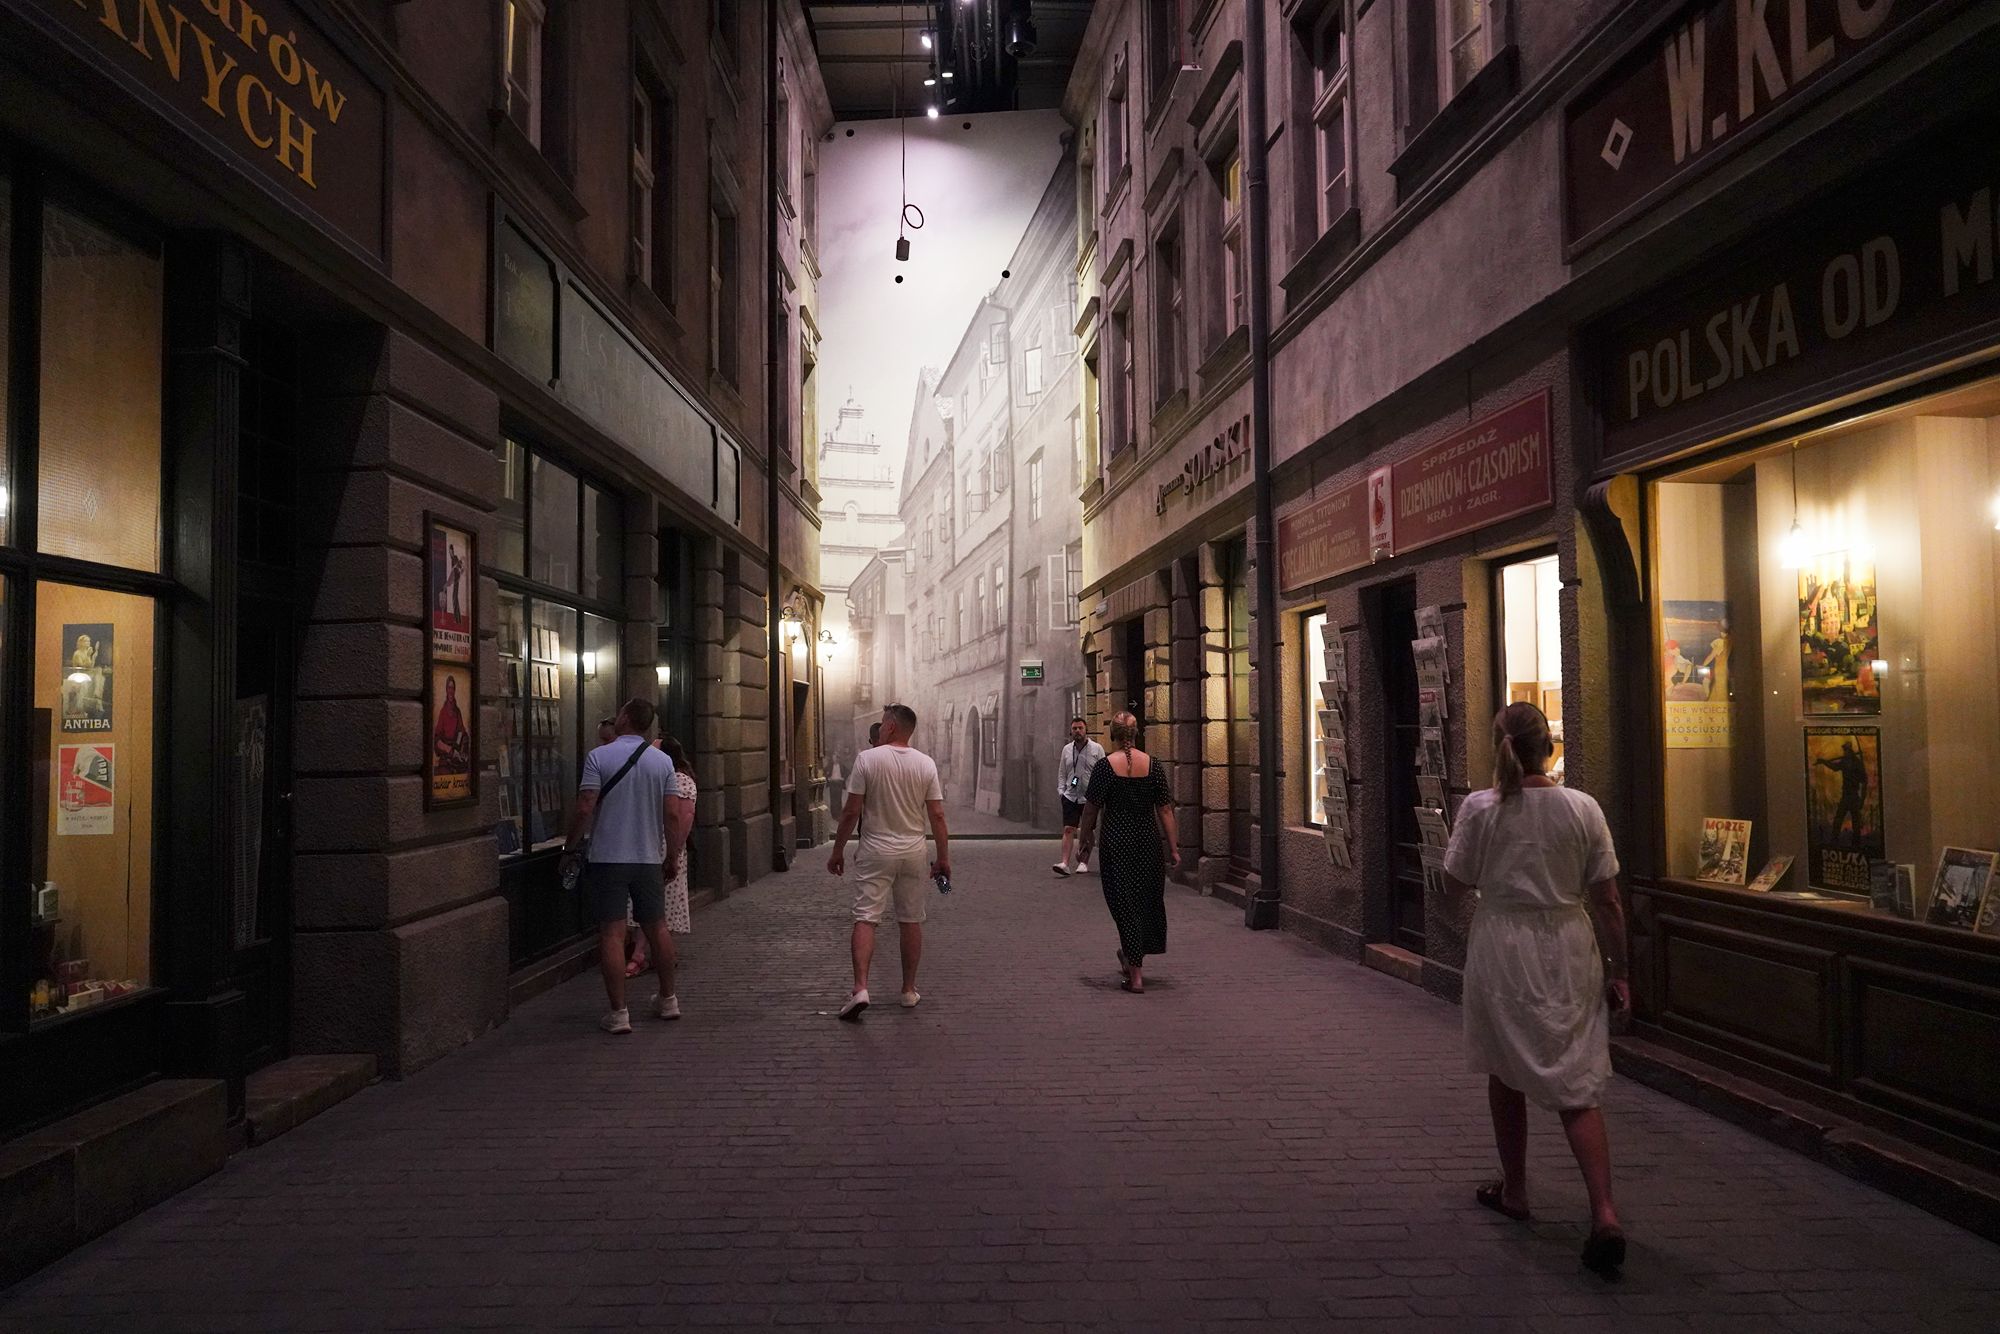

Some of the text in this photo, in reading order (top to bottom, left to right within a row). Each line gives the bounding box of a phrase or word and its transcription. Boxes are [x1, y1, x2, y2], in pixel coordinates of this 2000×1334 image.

[1628, 186, 2000, 419] POLSKA OD M
[1183, 414, 1250, 496] SOLSKI
[1421, 427, 1498, 471] SPRZEDAŻ
[1400, 464, 1464, 519] DZIENNIKÓW
[1467, 432, 1541, 492] CZASOPISM
[1466, 490, 1501, 510] ZAGR.
[63, 718, 111, 730] ANTIBA
[1705, 820, 1745, 832] MORZE
[1822, 849, 1868, 866] POLSKA
